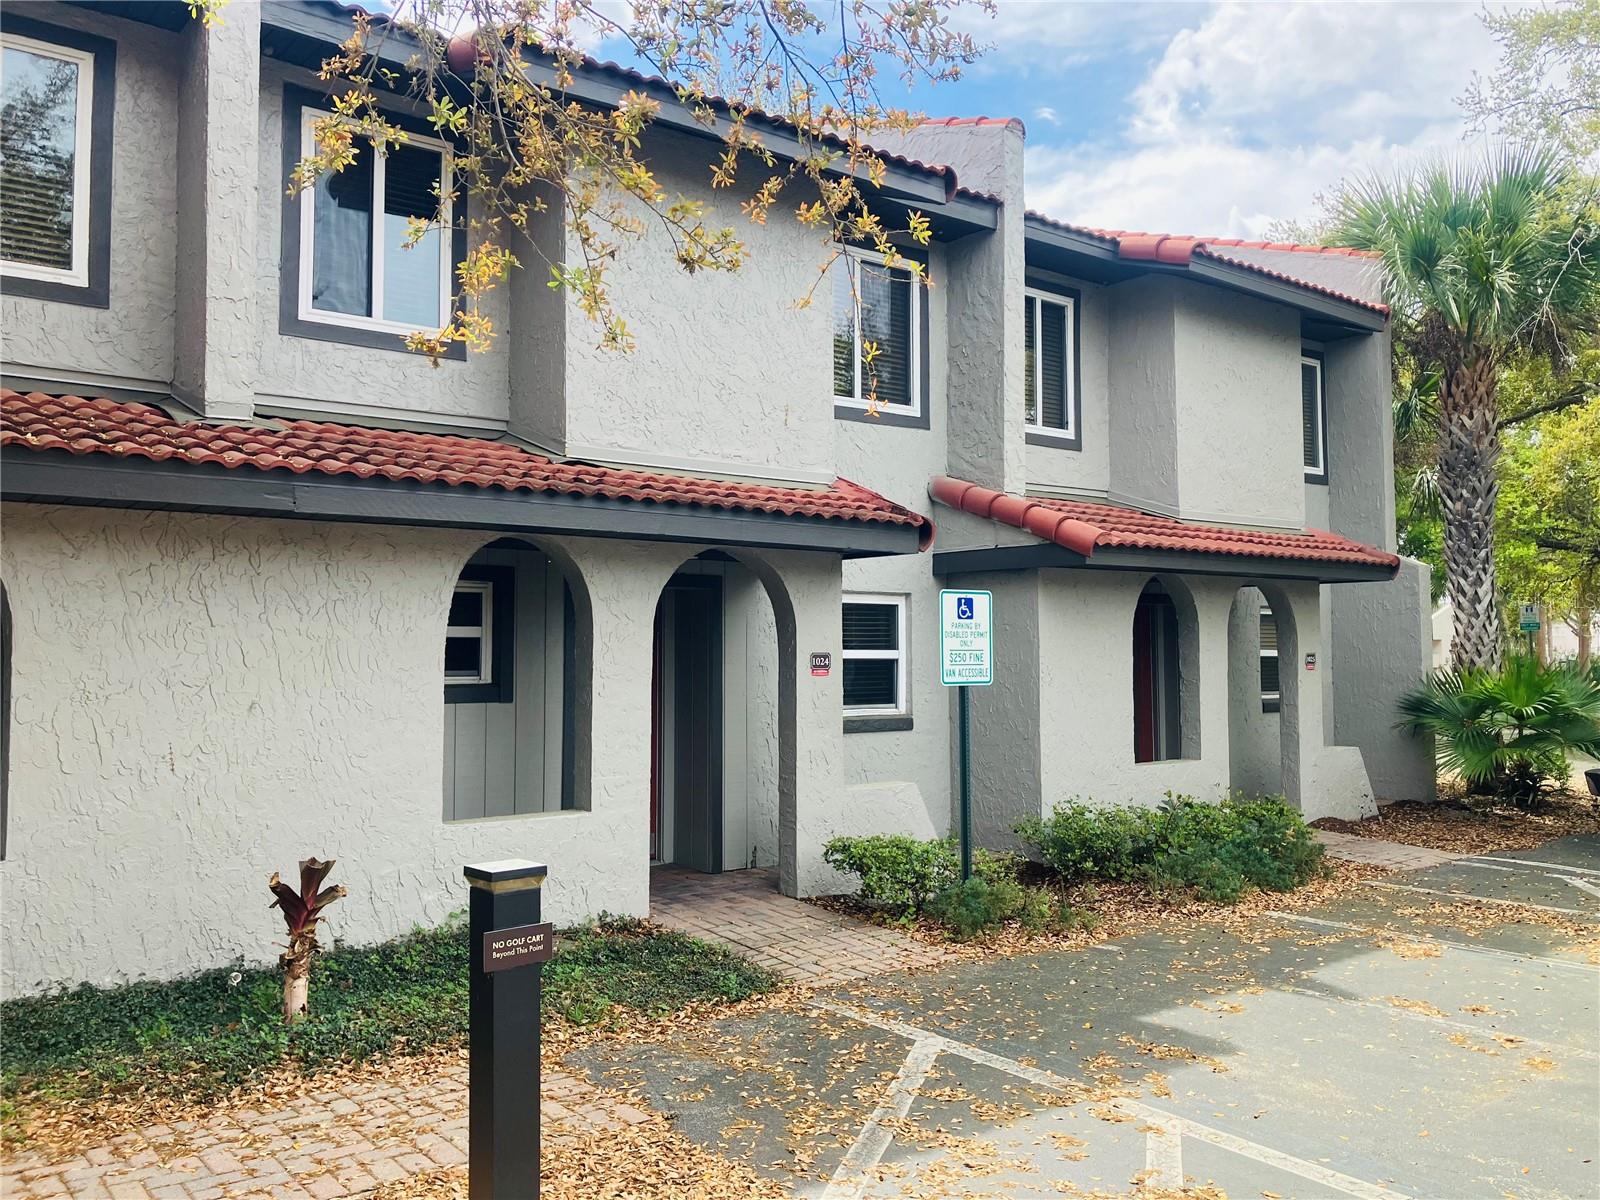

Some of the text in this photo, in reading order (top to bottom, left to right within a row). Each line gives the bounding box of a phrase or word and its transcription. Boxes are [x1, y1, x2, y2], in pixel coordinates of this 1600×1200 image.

[949, 652, 984, 663] $250 FINE
[946, 668, 988, 678] VAN ACCESSIBLE
[493, 934, 544, 949] NO GOLF CART
[493, 948, 515, 959] Beyond
[516, 946, 528, 954] This
